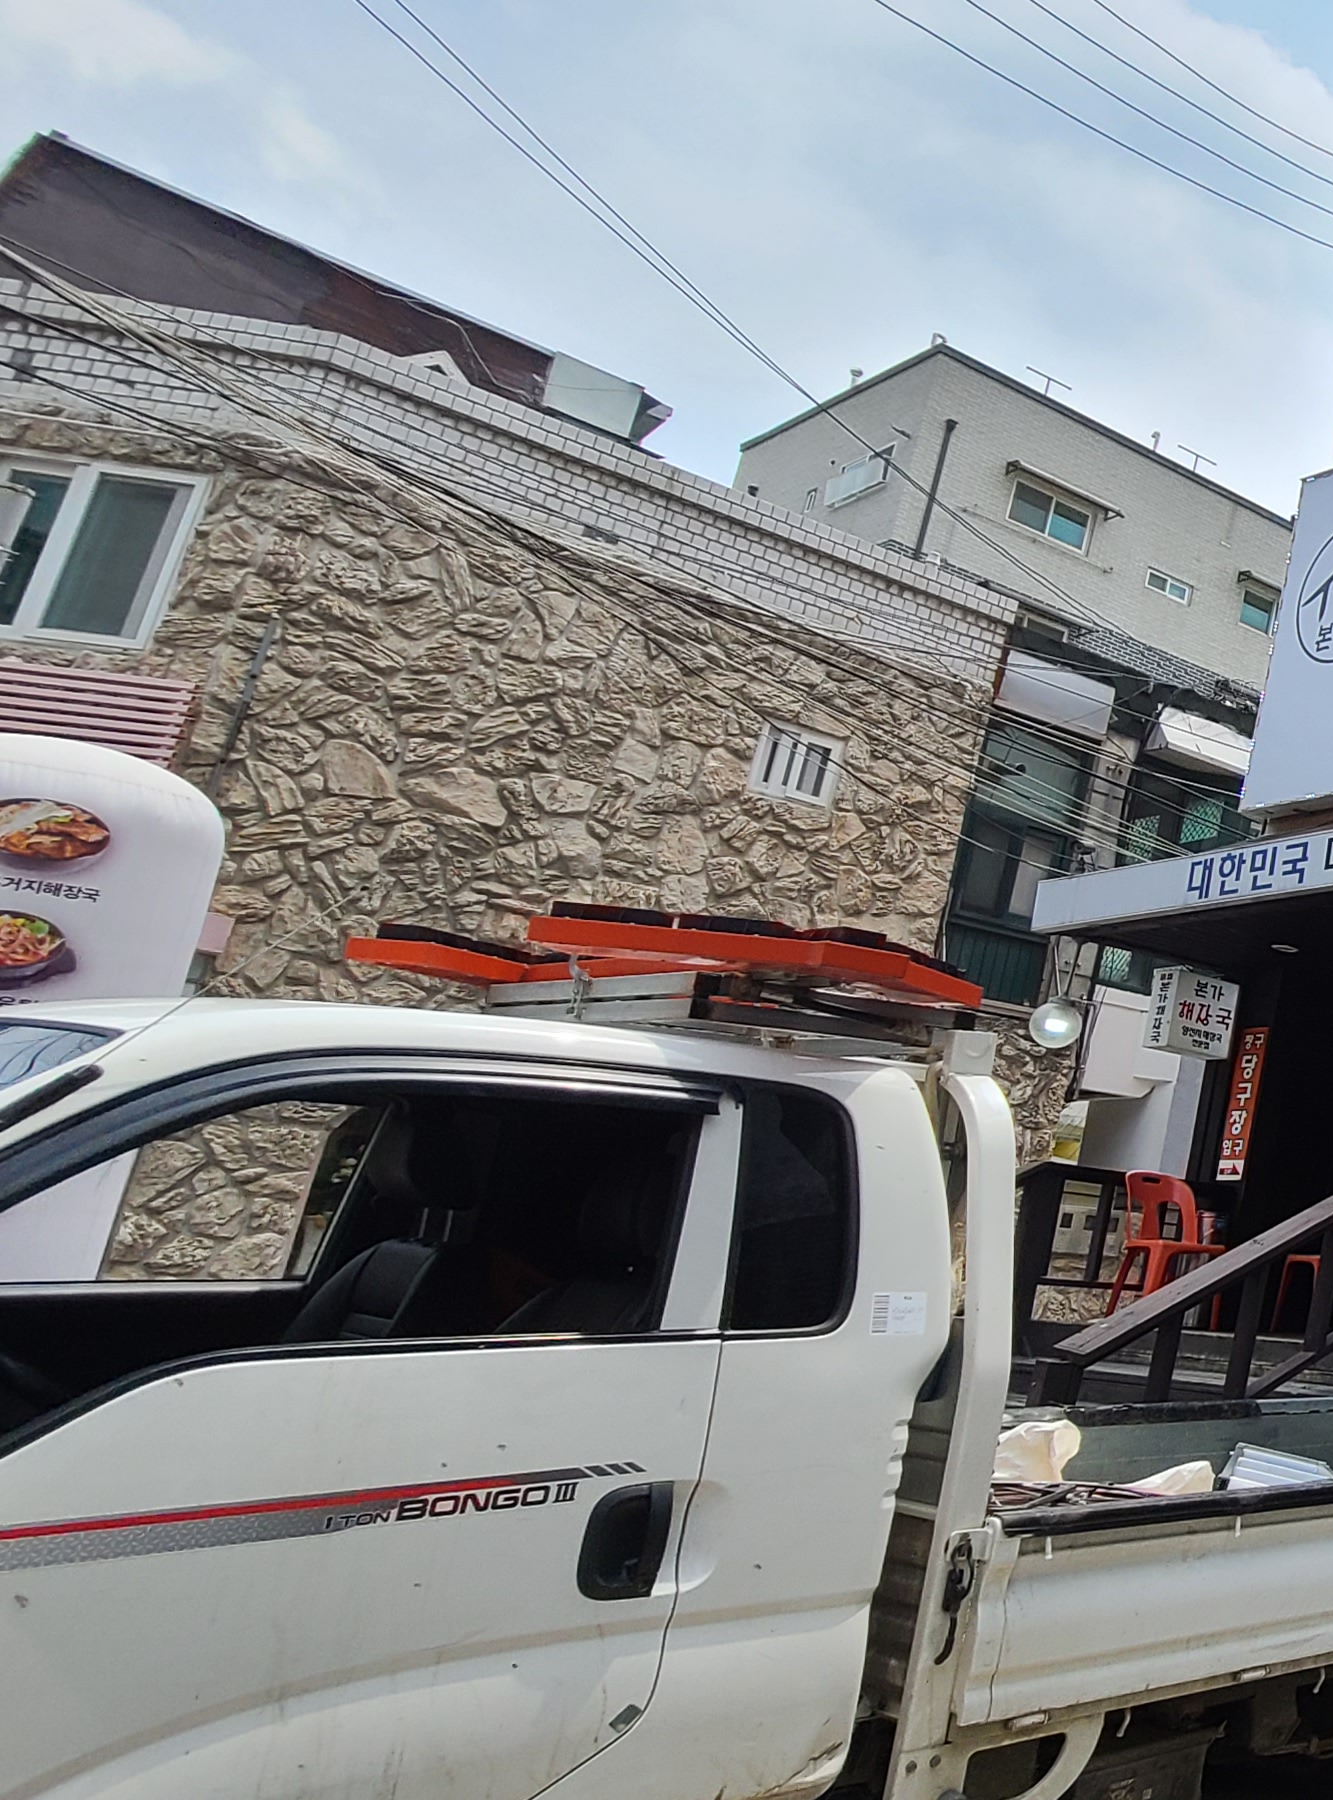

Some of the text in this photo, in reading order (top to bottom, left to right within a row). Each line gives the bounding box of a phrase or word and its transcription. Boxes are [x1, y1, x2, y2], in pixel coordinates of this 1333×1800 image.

[1186, 842, 1311, 900] 대한민국
[0, 877, 101, 903] 거지해장국
[1194, 979, 1225, 1002] 본가
[1178, 999, 1232, 1032] 해장국
[1229, 1054, 1258, 1136] 당구장
[1222, 1138, 1244, 1157] 입구
[340, 1509, 392, 1528] TON
[395, 1484, 551, 1522] BONGO
